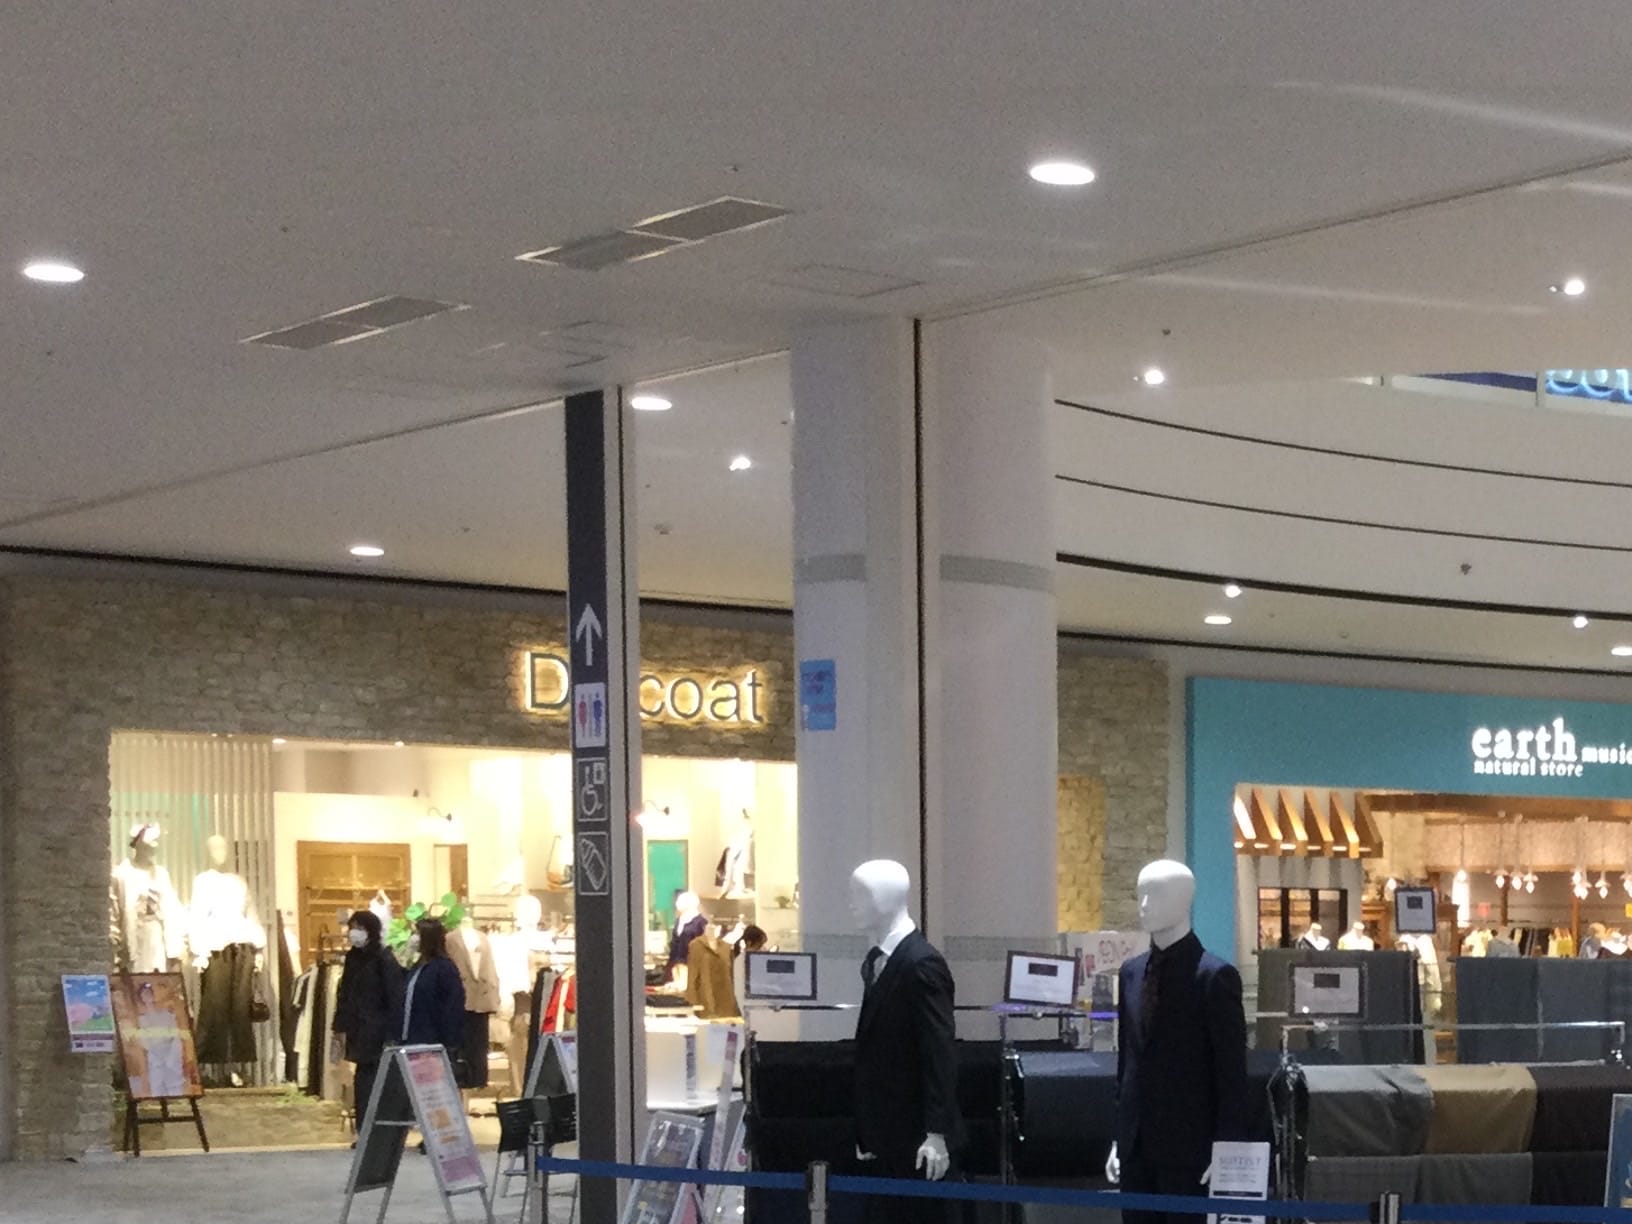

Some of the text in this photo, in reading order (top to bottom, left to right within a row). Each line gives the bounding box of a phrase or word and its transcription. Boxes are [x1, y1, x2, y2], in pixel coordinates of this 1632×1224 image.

[525, 650, 765, 723] Dcoat
[1472, 717, 1578, 762] earth
[1473, 758, 1584, 777] natural store
